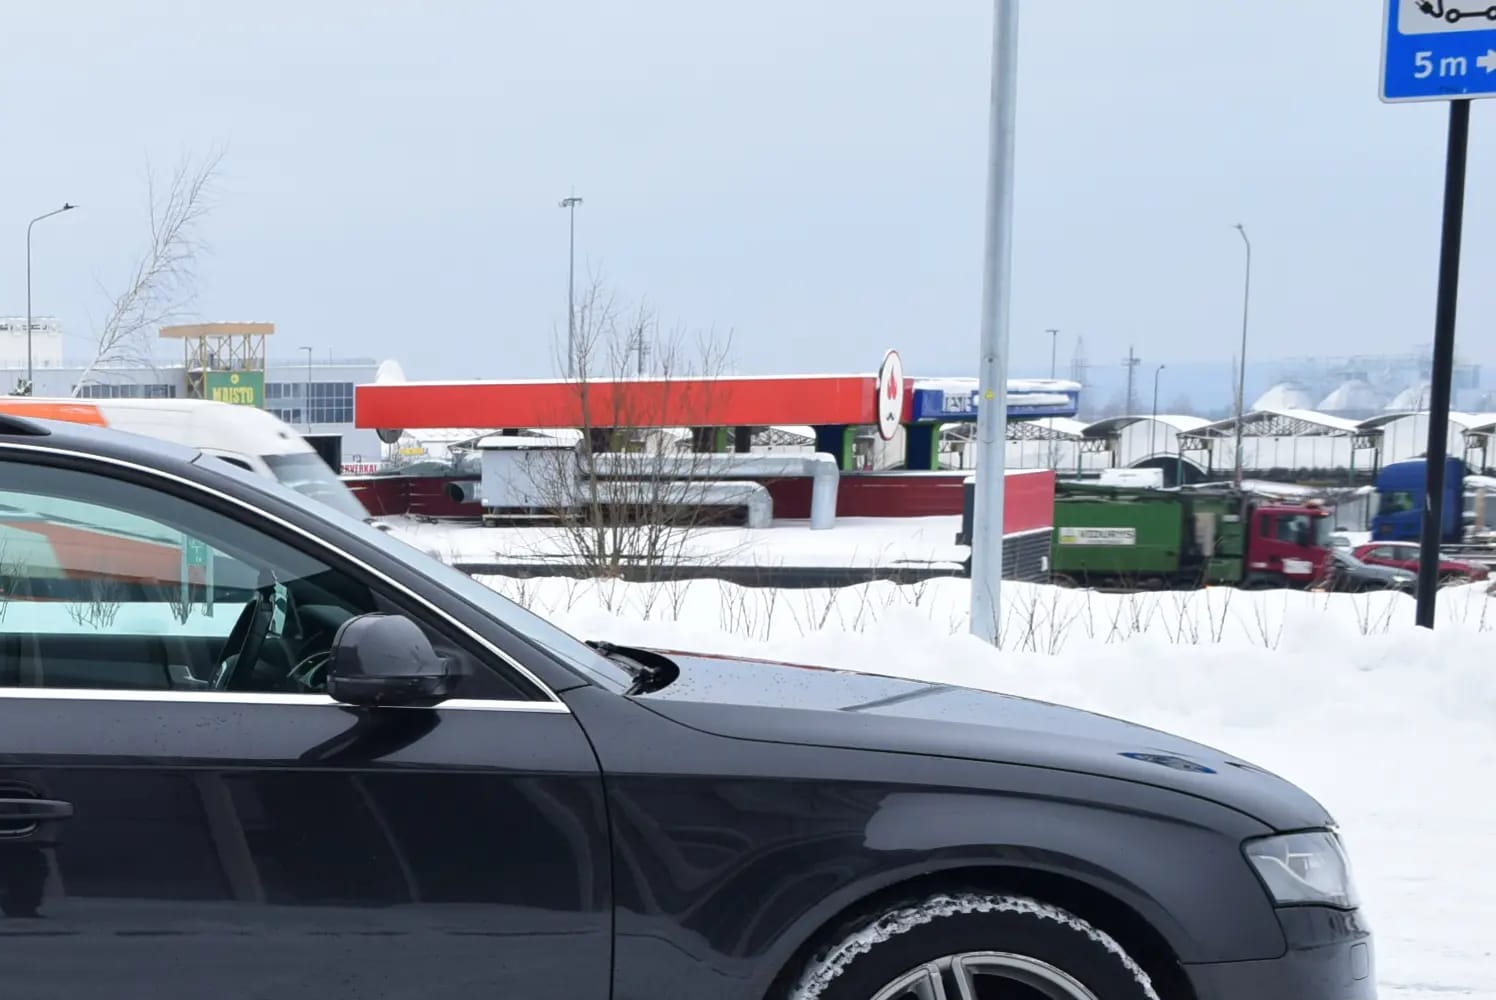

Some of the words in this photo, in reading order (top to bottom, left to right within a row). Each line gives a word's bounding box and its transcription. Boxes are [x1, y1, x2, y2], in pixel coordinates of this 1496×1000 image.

[1414, 51, 1433, 79] 5
[1439, 56, 1468, 77] m
[212, 387, 254, 404] MAISTO
